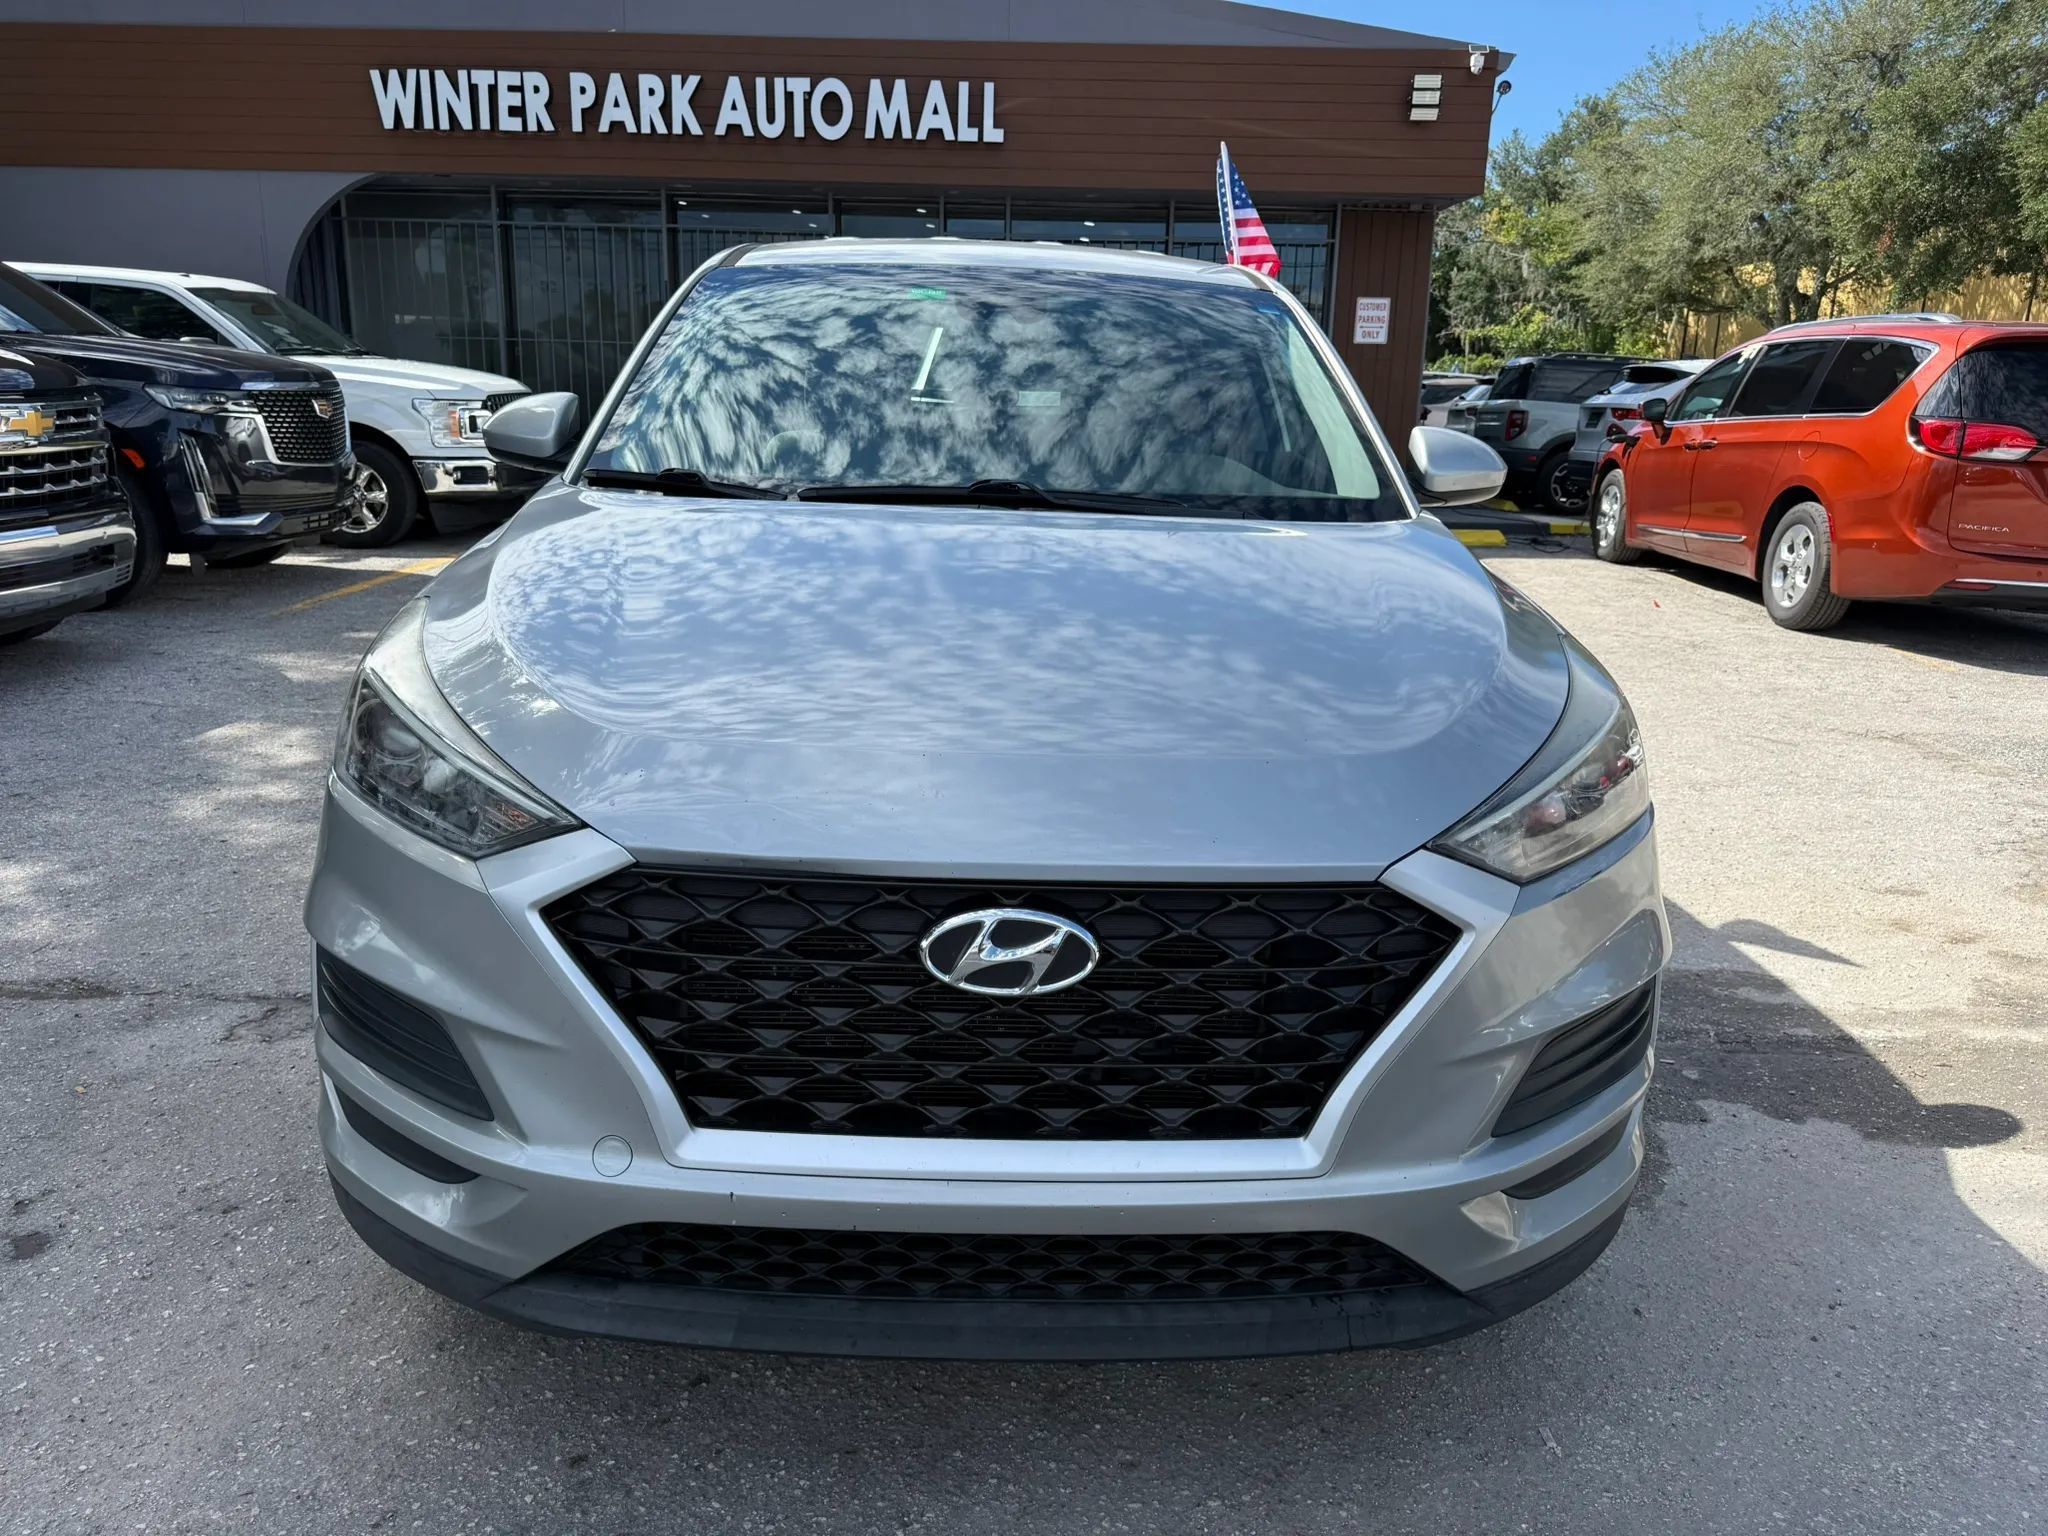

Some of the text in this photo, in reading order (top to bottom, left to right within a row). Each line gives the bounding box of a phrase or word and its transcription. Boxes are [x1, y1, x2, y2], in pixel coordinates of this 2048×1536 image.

[369, 68, 1006, 144] WINTER PARK AUTO MALL
[1359, 315, 1385, 324] PARKING
[1361, 330, 1380, 339] ONLY
[1958, 523, 2010, 532] PACIFICA
